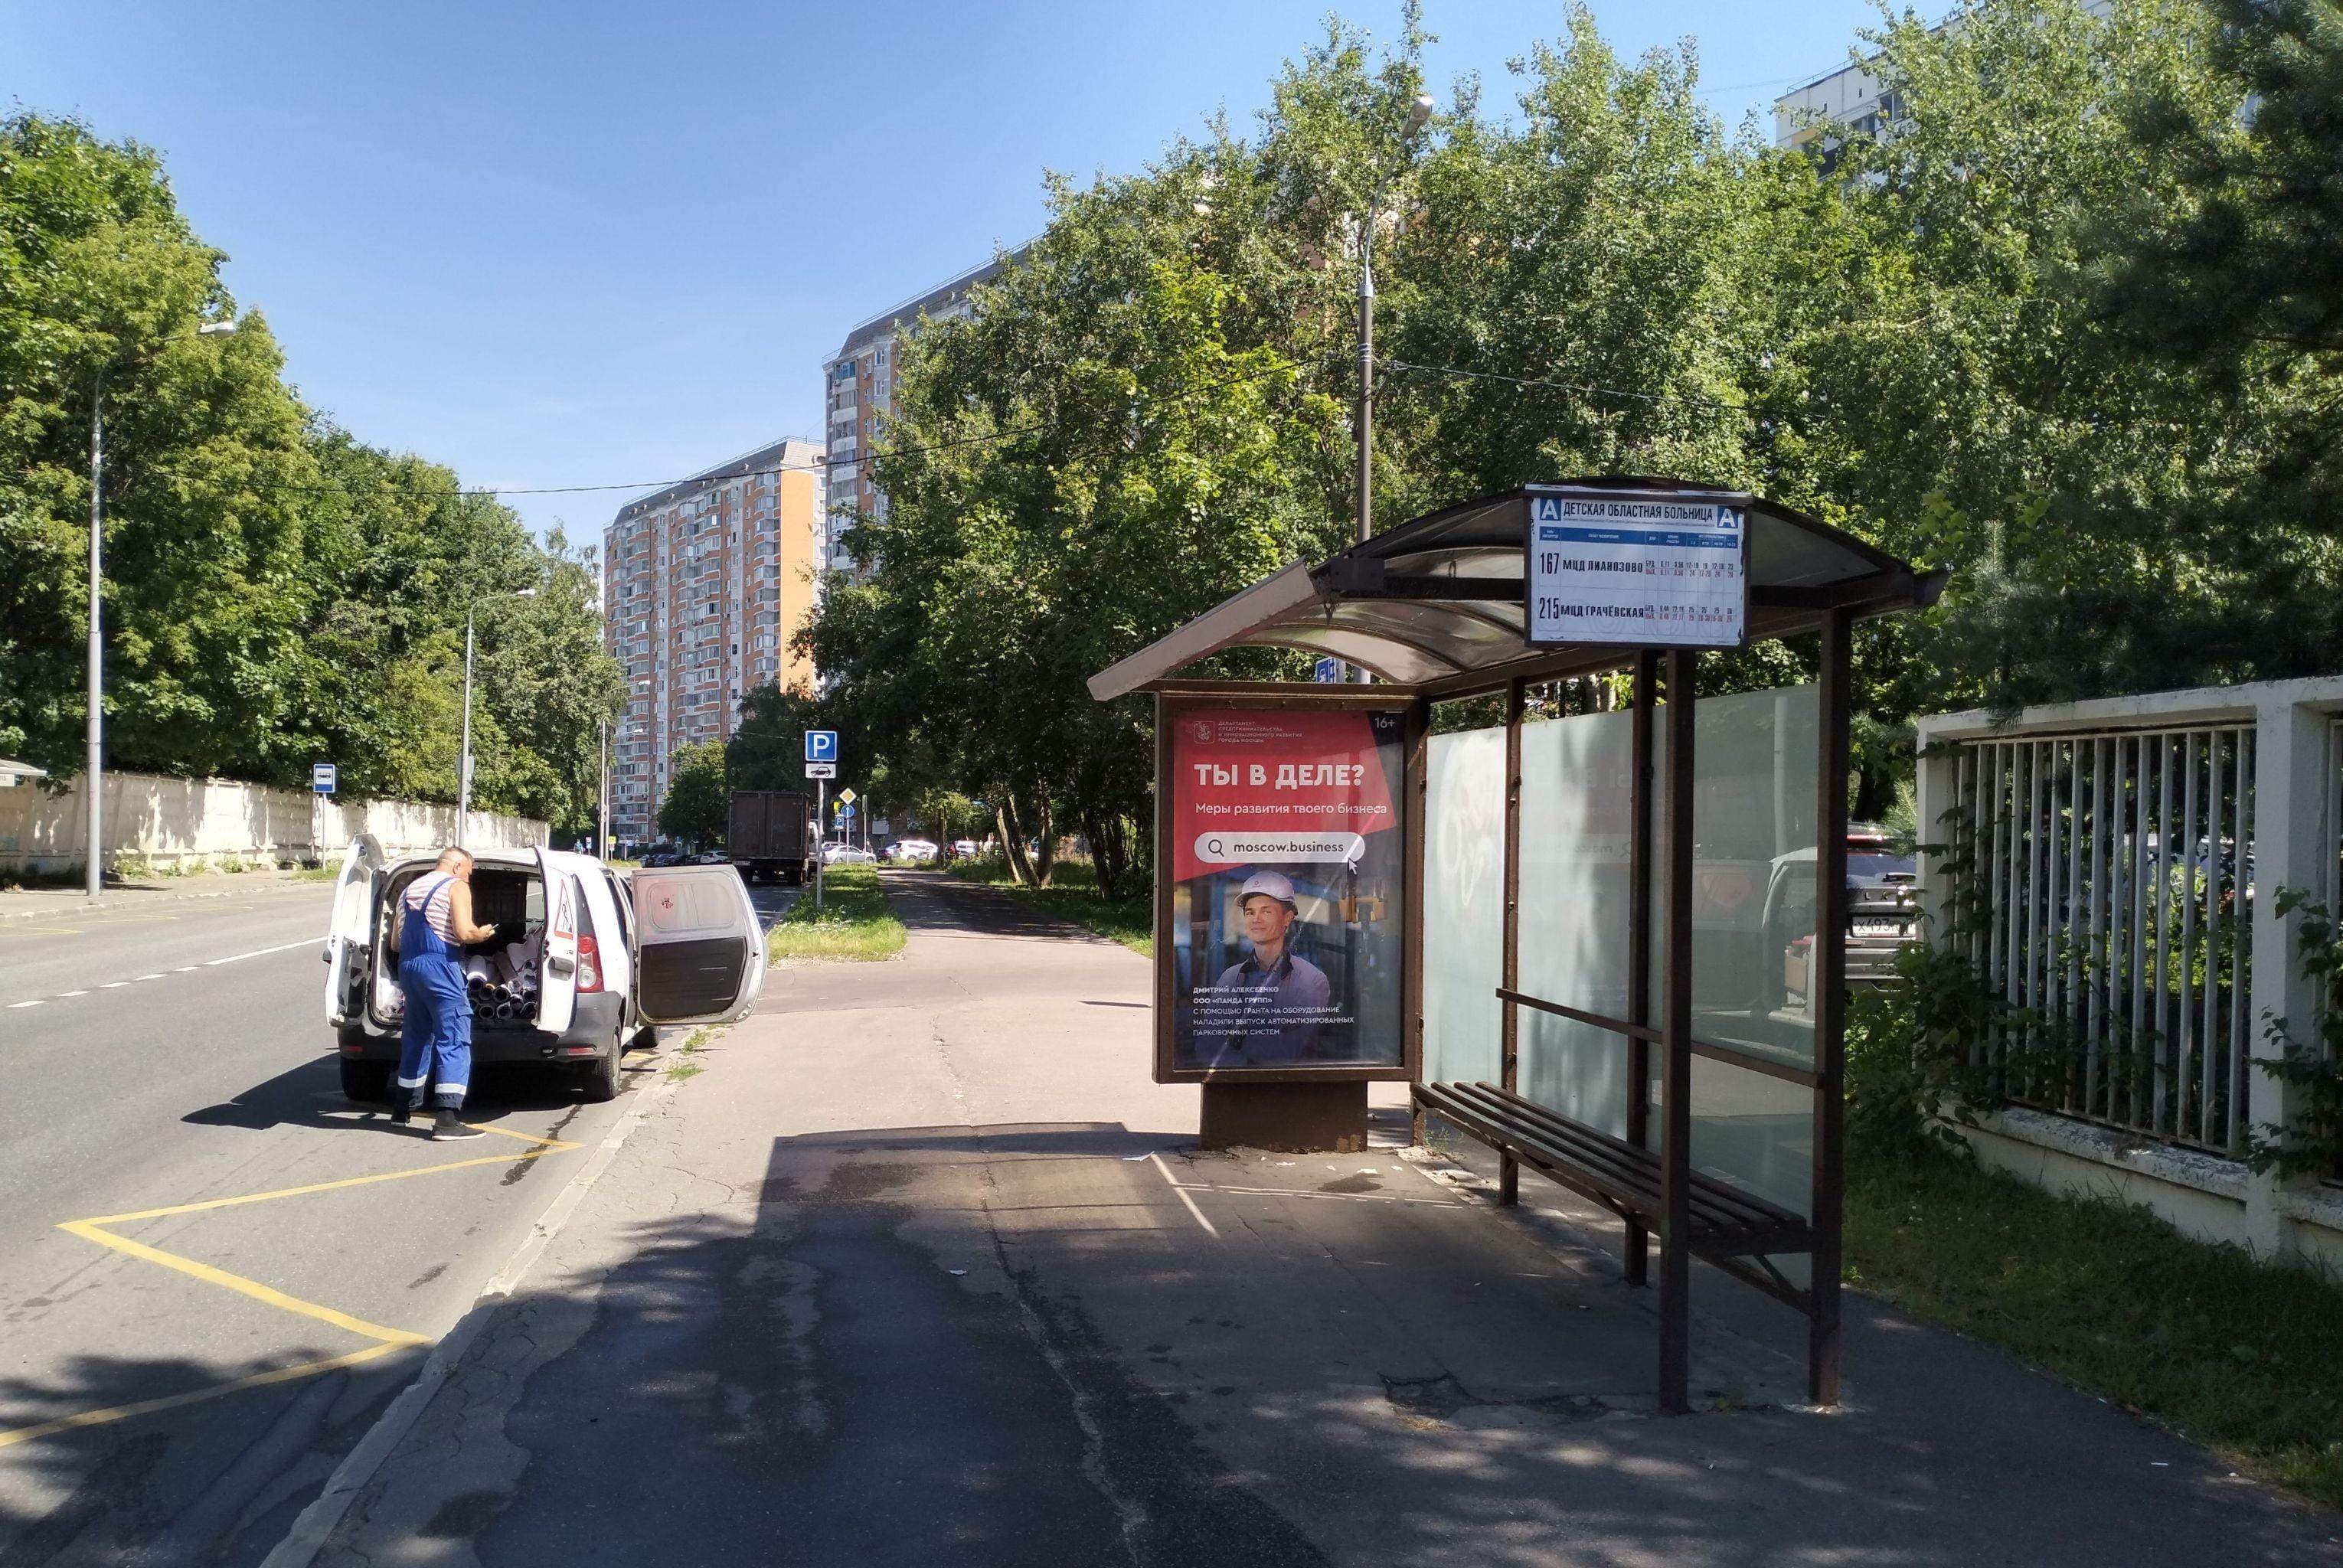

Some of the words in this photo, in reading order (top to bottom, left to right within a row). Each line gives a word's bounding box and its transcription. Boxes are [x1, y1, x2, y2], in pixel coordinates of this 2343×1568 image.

[1564, 502, 1605, 517] ДЕТСКАЯ
[1608, 505, 1662, 518] ОБЛАСТНАЯ
[1664, 506, 1713, 522] БОЛЬНИЦА
[1540, 552, 1560, 574] 167
[1563, 560, 1585, 572] МЦД
[1587, 560, 1643, 573] ЛИАНОЗОВО
[1539, 597, 1560, 619] 215
[1560, 605, 1583, 617] МЦД
[1585, 605, 1644, 618] ГРАЧЁВСКАЯ
[1375, 717, 1396, 729] 16+
[813, 734, 830, 757] P
[1194, 764, 1238, 786] ТЫ
[1250, 764, 1267, 786] В
[1275, 764, 1365, 790] ДЕЛЕ?
[1195, 802, 1231, 816] Меры
[1234, 804, 1289, 816] развития
[1293, 805, 1334, 814] твоего
[1338, 802, 1387, 814] бизнеса
[1234, 841, 1344, 853] moscow.business
[1193, 985, 1230, 994] ДМИТРИЙ
